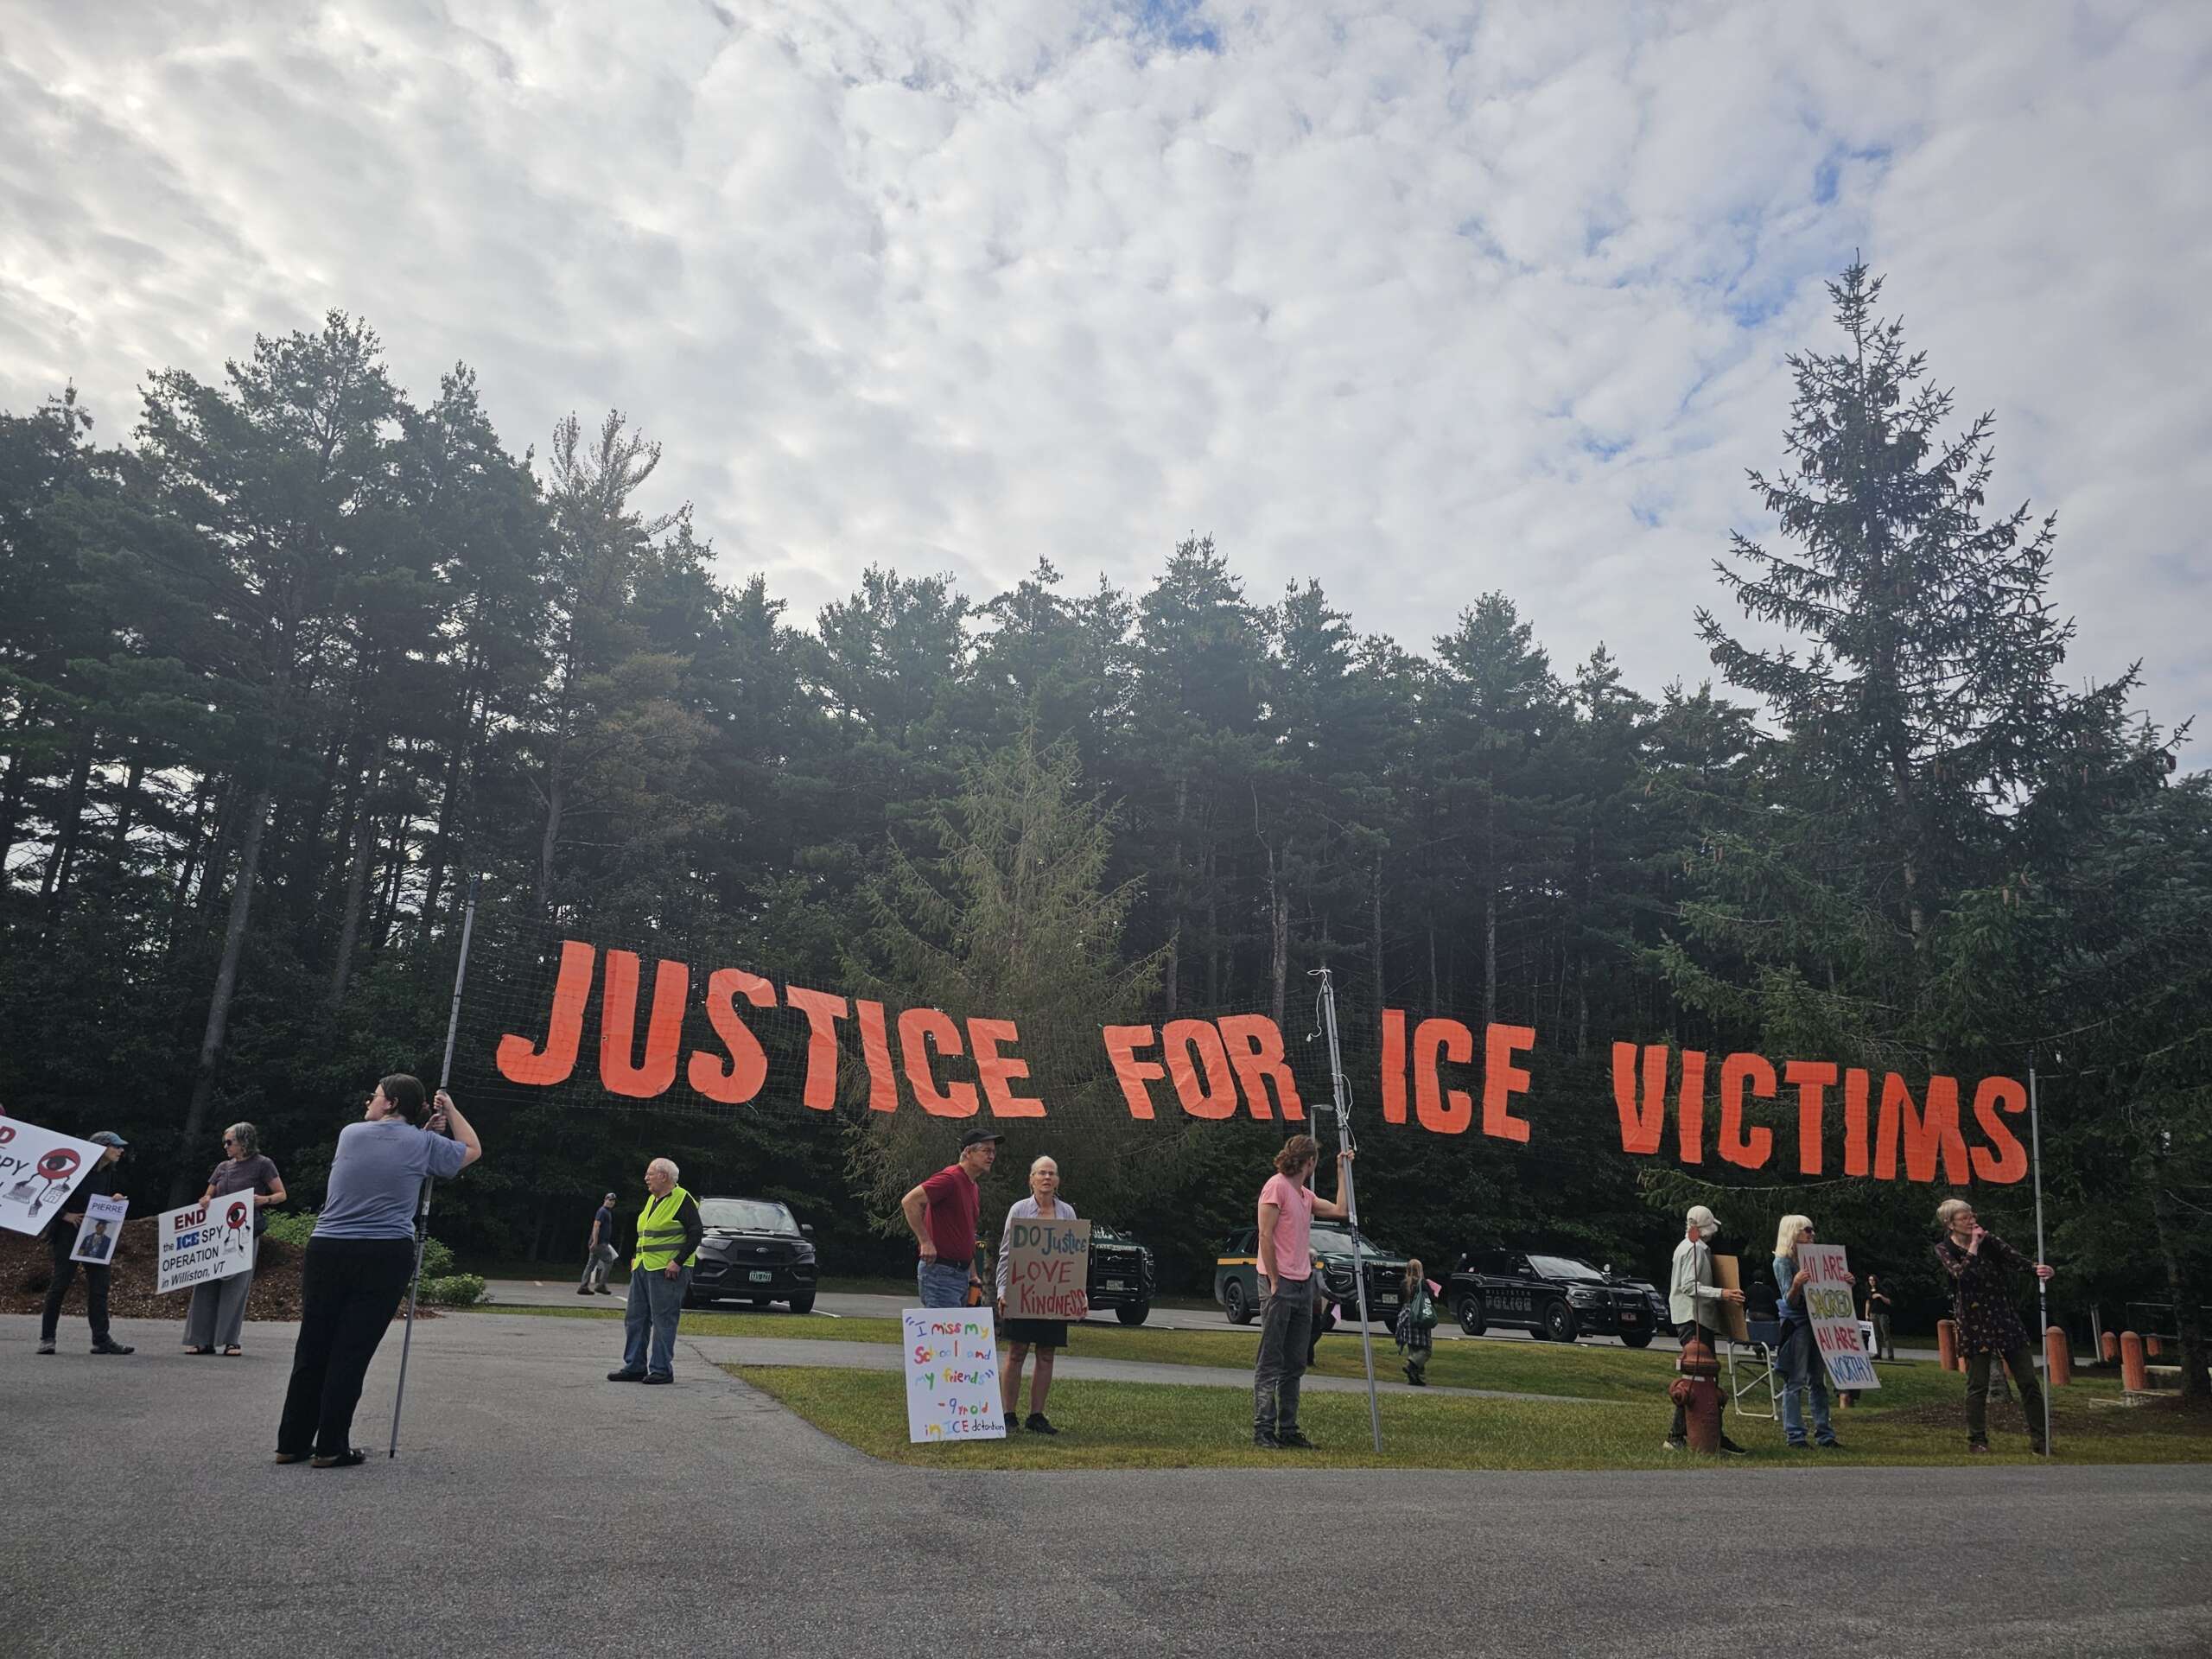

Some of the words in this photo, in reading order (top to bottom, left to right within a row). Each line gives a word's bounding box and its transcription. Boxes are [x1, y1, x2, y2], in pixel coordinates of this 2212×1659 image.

[496, 940, 1047, 1118] JUSTICE
[1103, 1014, 1306, 1120] FOR
[1382, 1009, 1536, 1143] ICE
[1612, 1041, 2028, 1185] VICTIMS
[91, 1202, 124, 1214] PIERRE
[175, 1209, 207, 1230] END
[163, 1243, 174, 1253] the
[176, 1230, 200, 1251] ICE
[201, 1225, 224, 1243] SPY
[1013, 1224, 1041, 1249] DO
[162, 1246, 219, 1272] OPERATION
[1822, 1254, 1846, 1281] ARE
[162, 1278, 169, 1288] in
[213, 1261, 226, 1274] VT
[1012, 1260, 1074, 1285] LOVE
[1485, 1296, 1532, 1312] POLICE
[1808, 1287, 1853, 1320] SACRED
[931, 1322, 962, 1336] miss
[964, 1323, 989, 1341] my
[1834, 1325, 1860, 1351] ARE
[967, 1349, 991, 1360] and
[915, 1371, 935, 1390] my
[1826, 1355, 1874, 1383] WORTHY
[943, 1420, 969, 1434] ICE
